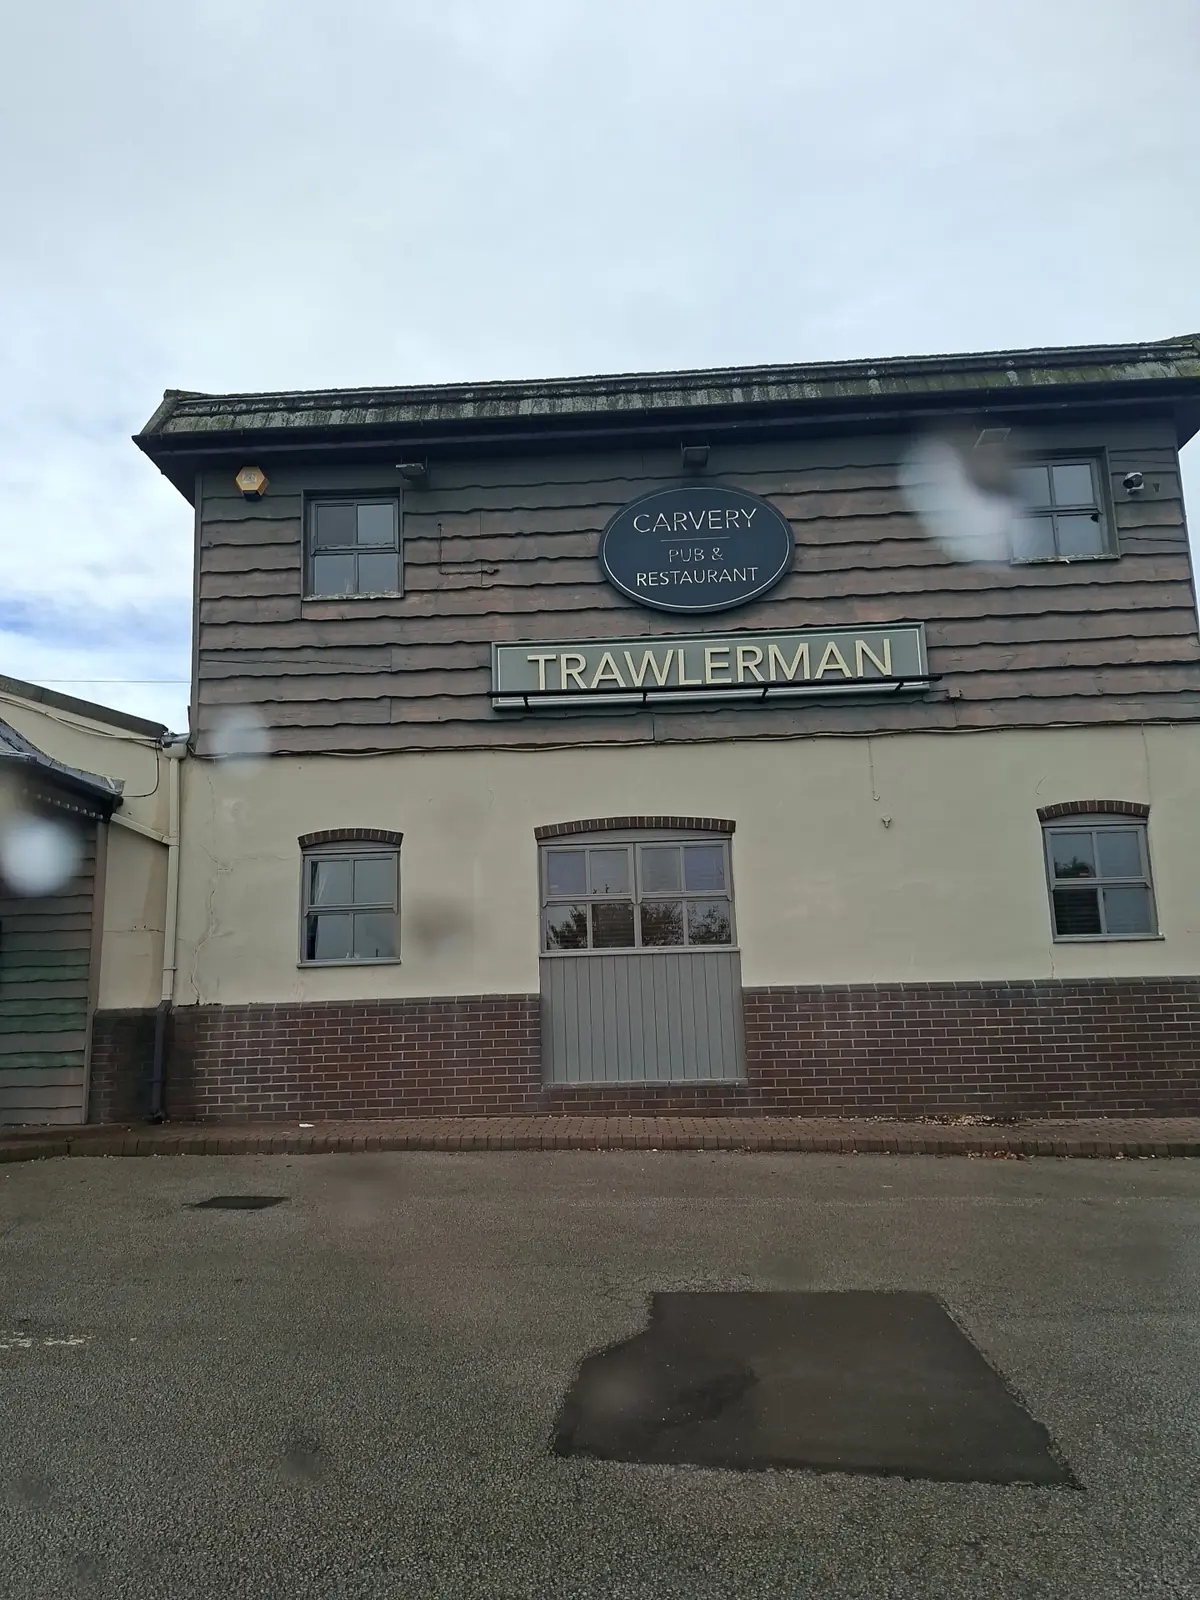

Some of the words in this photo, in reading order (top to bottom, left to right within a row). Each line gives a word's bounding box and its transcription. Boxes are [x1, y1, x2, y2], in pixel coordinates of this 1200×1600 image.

[633, 508, 757, 534] CARVERY
[668, 547, 705, 563] PUB
[711, 546, 724, 561] &
[636, 567, 759, 587] RESTAURANT
[527, 638, 893, 690] TRAWLERMAN
